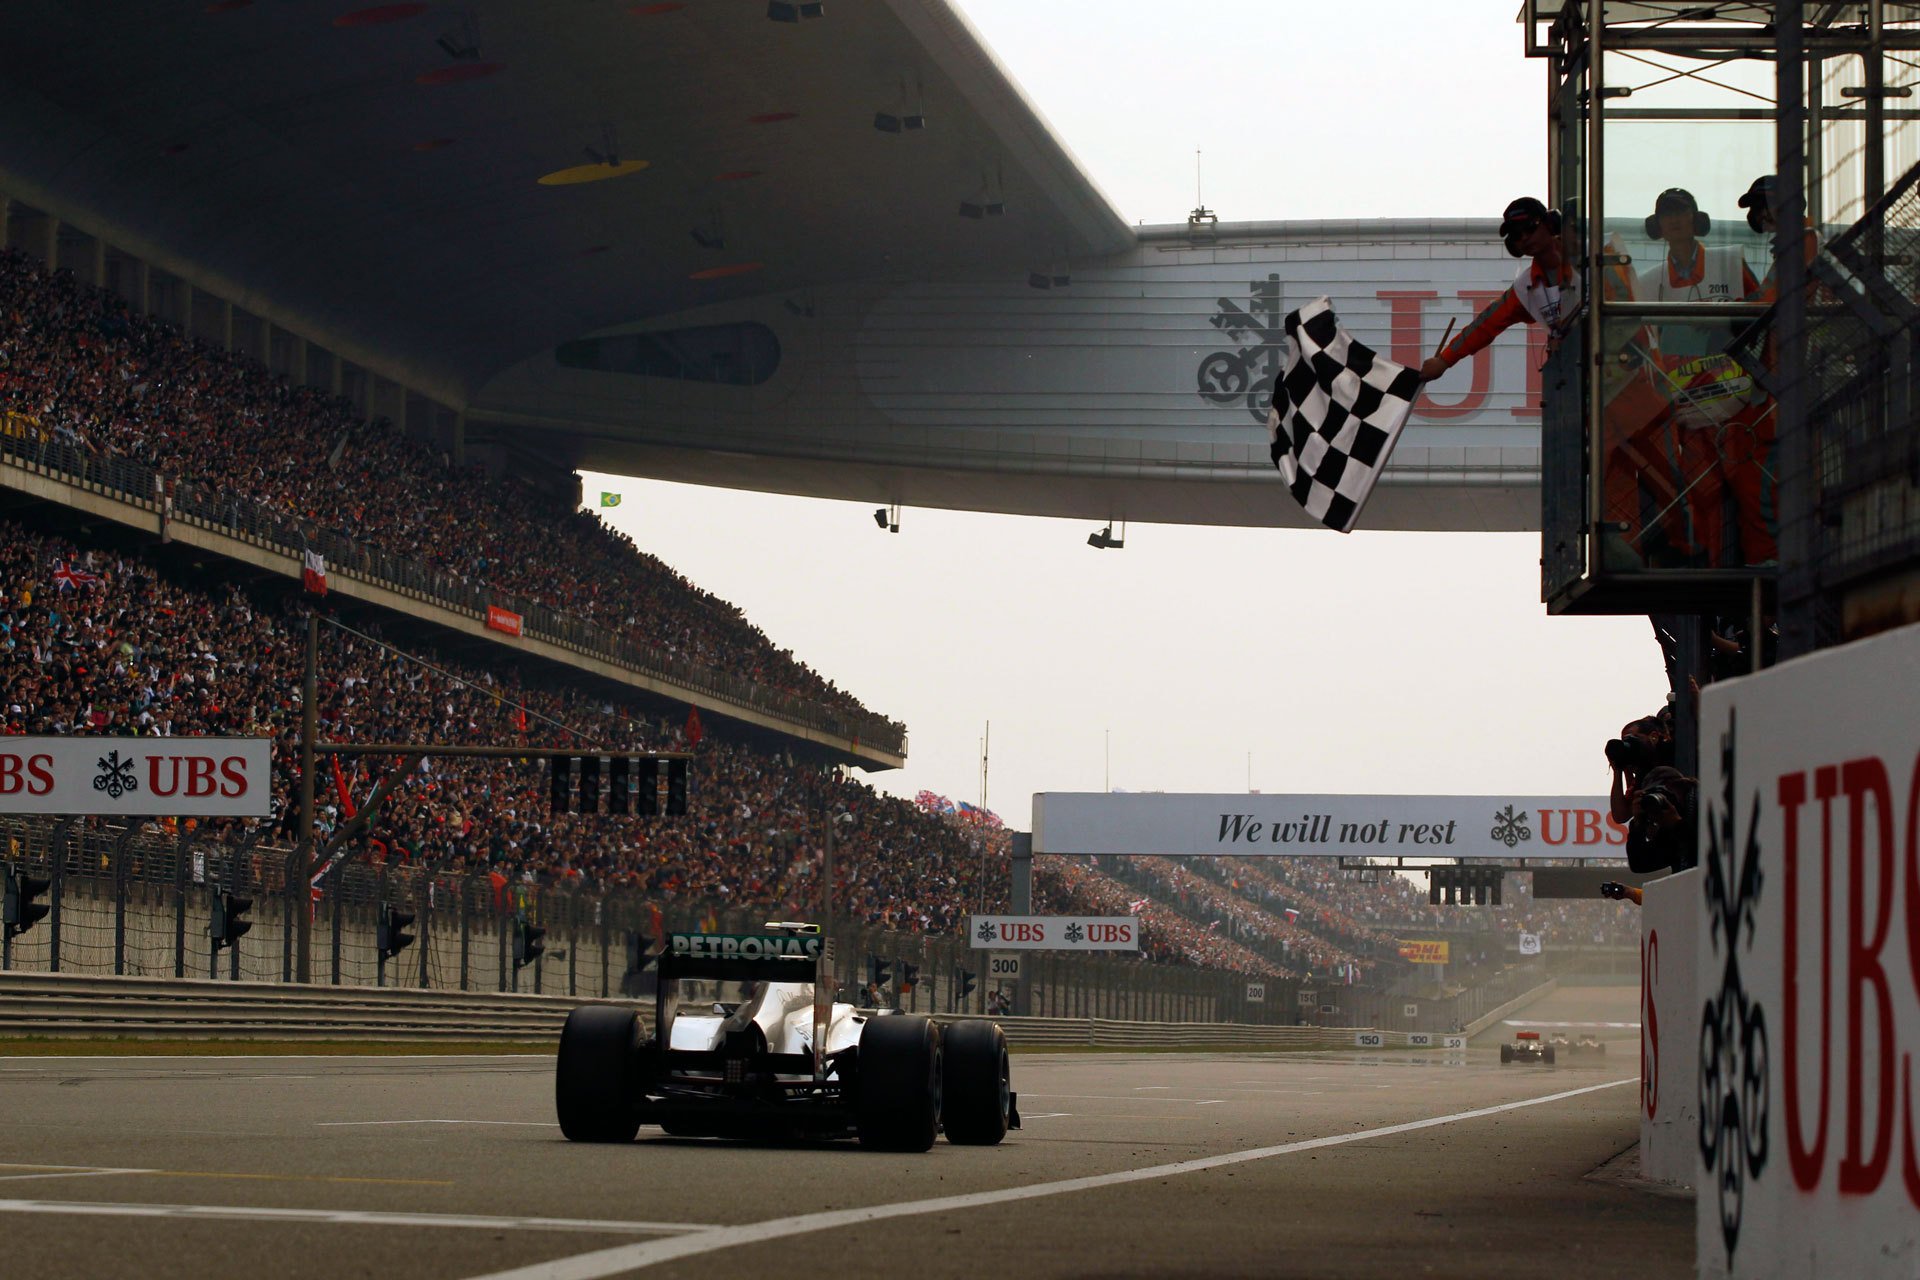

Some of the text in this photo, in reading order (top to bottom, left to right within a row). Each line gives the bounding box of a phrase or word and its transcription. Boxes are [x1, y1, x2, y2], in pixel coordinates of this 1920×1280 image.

[1709, 284, 1728, 294] 2011
[145, 756, 248, 798] UBS
[1218, 809, 1629, 846] We will not rest UBS
[1000, 923, 1132, 943] UBS UBS
[672, 936, 819, 961] PETRONAS
[992, 959, 1018, 973] 300
[1249, 987, 1263, 998] 200
[1360, 1035, 1379, 1045] 150
[1411, 1036, 1428, 1044] 100
[1450, 1040, 1461, 1048] 50
